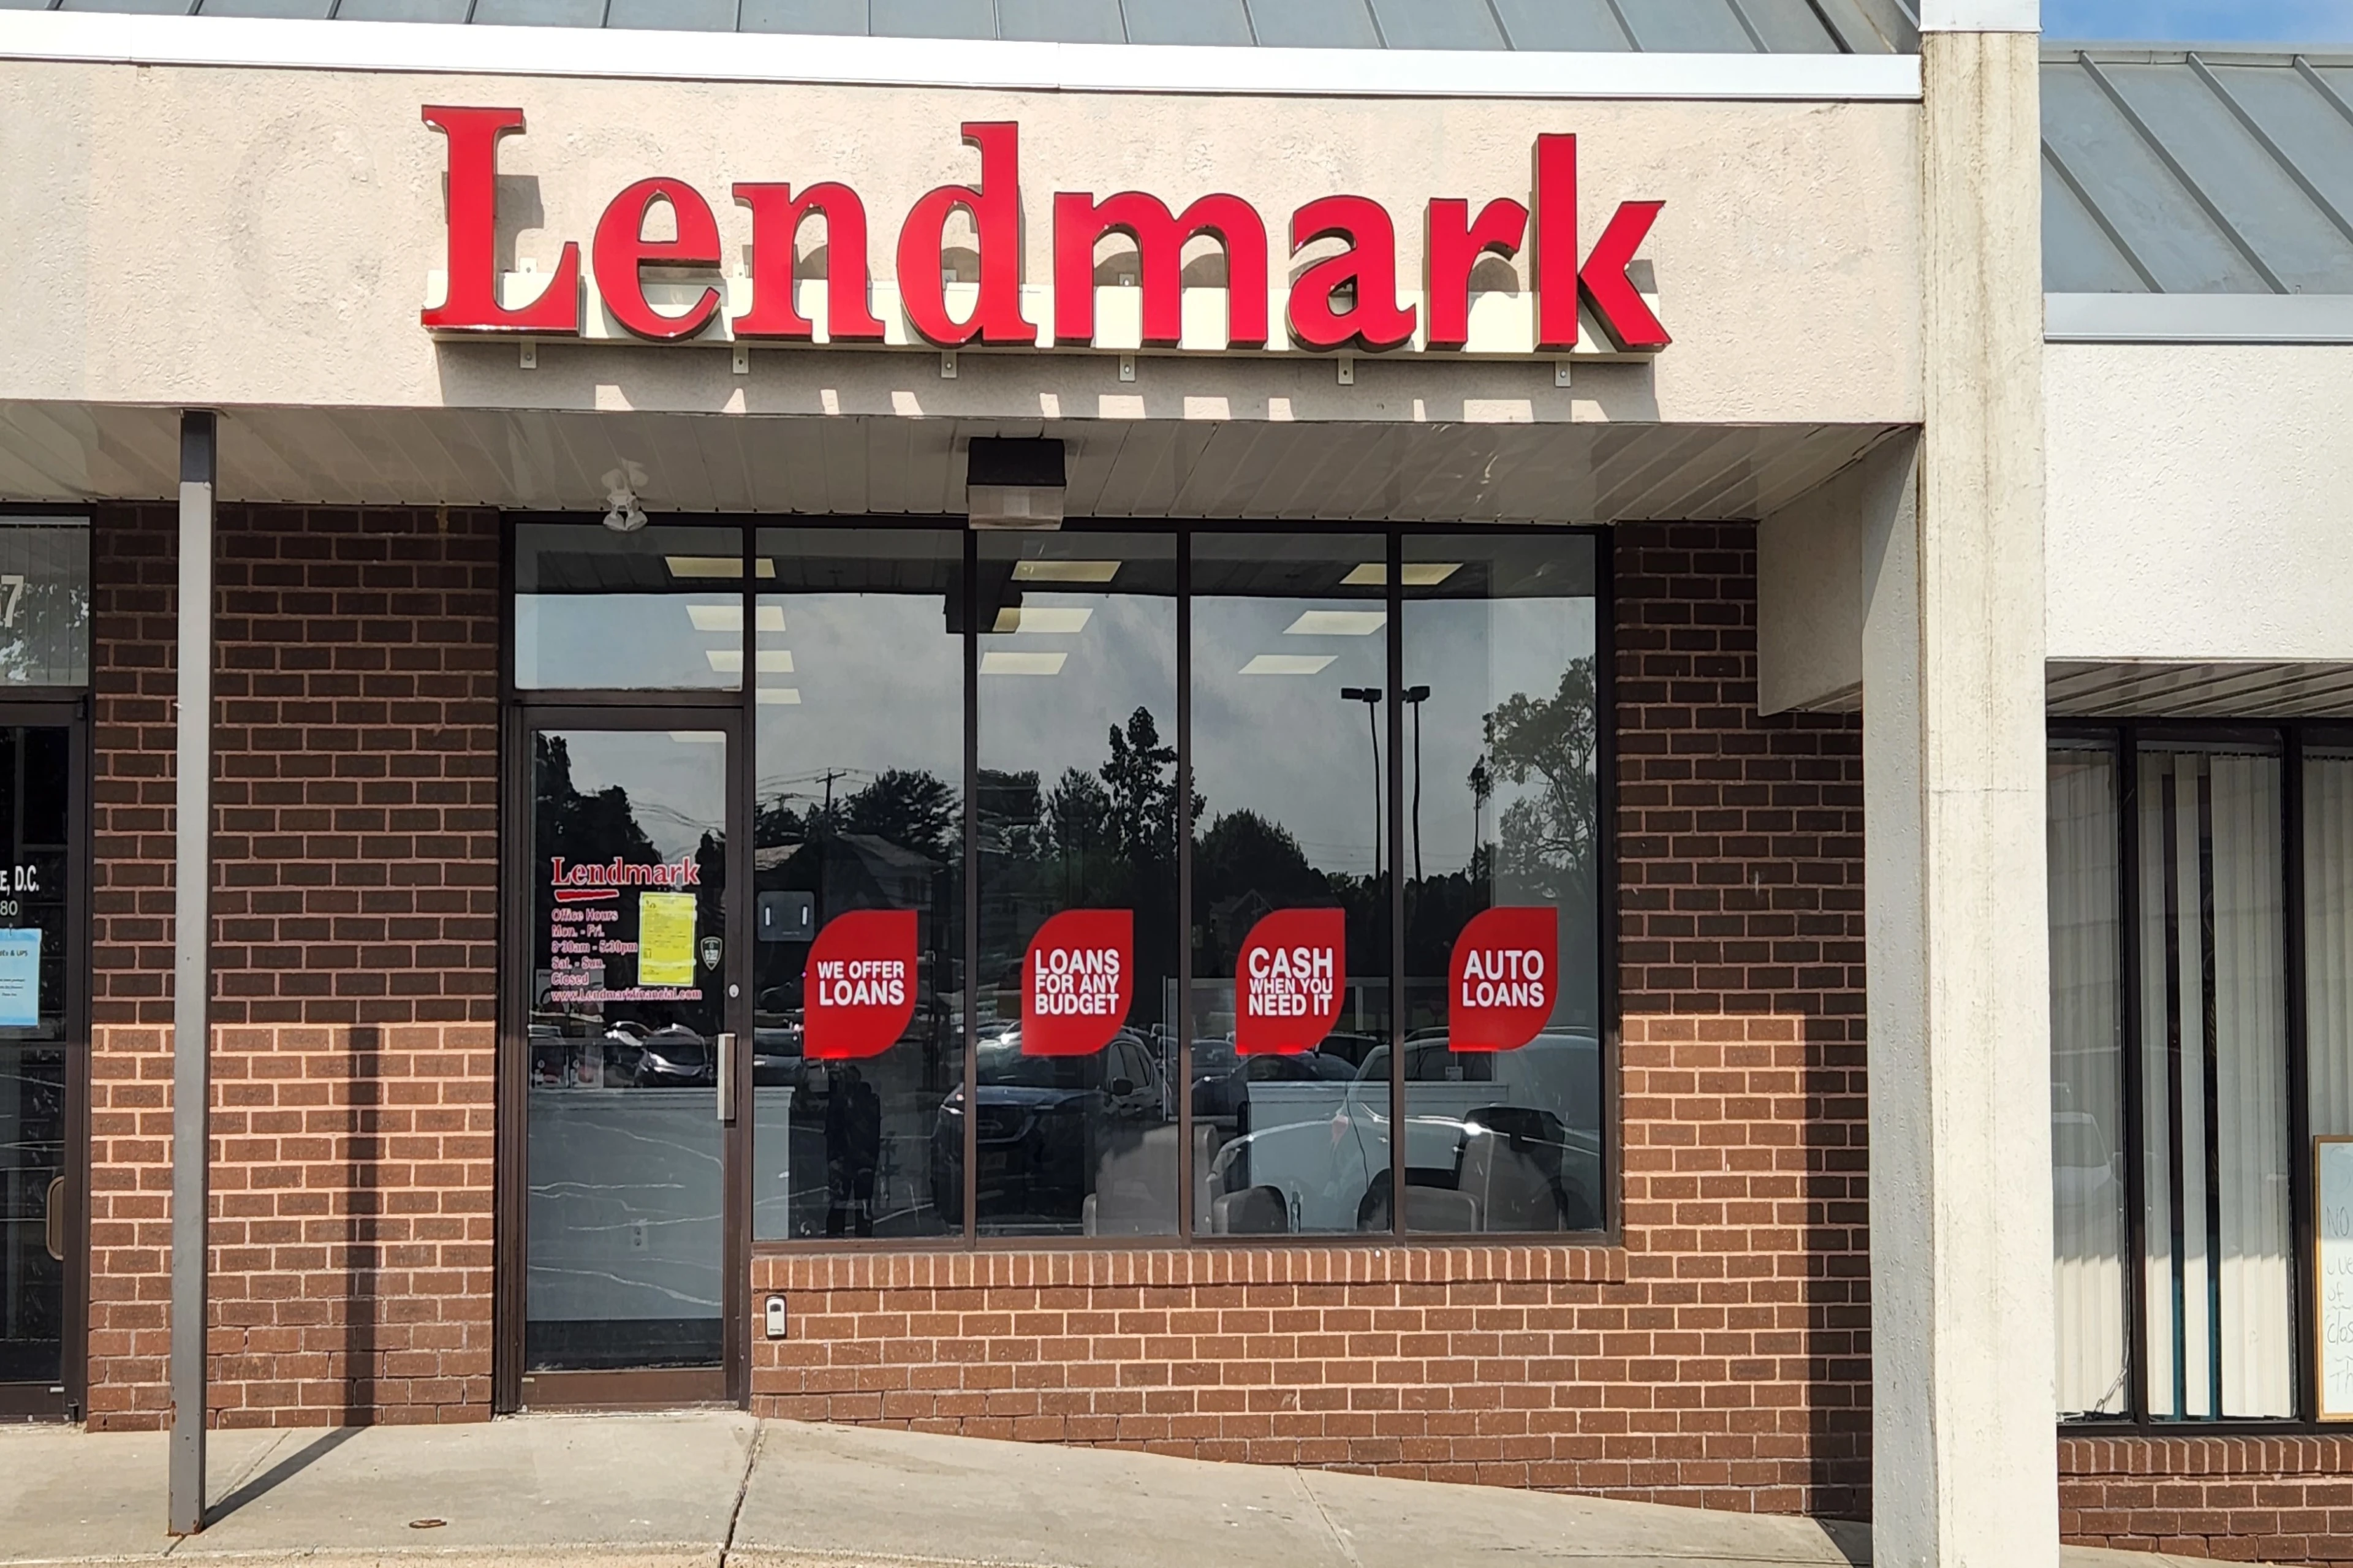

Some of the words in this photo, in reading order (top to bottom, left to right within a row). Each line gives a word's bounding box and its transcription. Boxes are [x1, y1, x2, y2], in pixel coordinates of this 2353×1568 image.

[420, 105, 1672, 353] Lendmark
[1, 575, 25, 627] 7
[15, 865, 39, 892] D.C.
[551, 857, 700, 885] Lendmark
[0, 900, 18, 915] 80
[585, 908, 619, 922] Hours
[817, 961, 844, 979] WE
[849, 961, 904, 979] OFFER
[1036, 949, 1120, 975] LOANS
[1249, 947, 1333, 979] CASH
[1463, 950, 1544, 980] AUTO
[551, 972, 589, 985] Closed
[1036, 974, 1074, 993] FOR
[1079, 974, 1120, 993] ANY
[1249, 978, 1295, 994] WHEN
[1300, 978, 1333, 994] YOU
[820, 980, 904, 1006] LOANS
[1036, 993, 1120, 1015] BUDGET
[1249, 994, 1306, 1015] NEED
[1314, 994, 1333, 1015] IT
[1463, 982, 1545, 1007] LOANS
